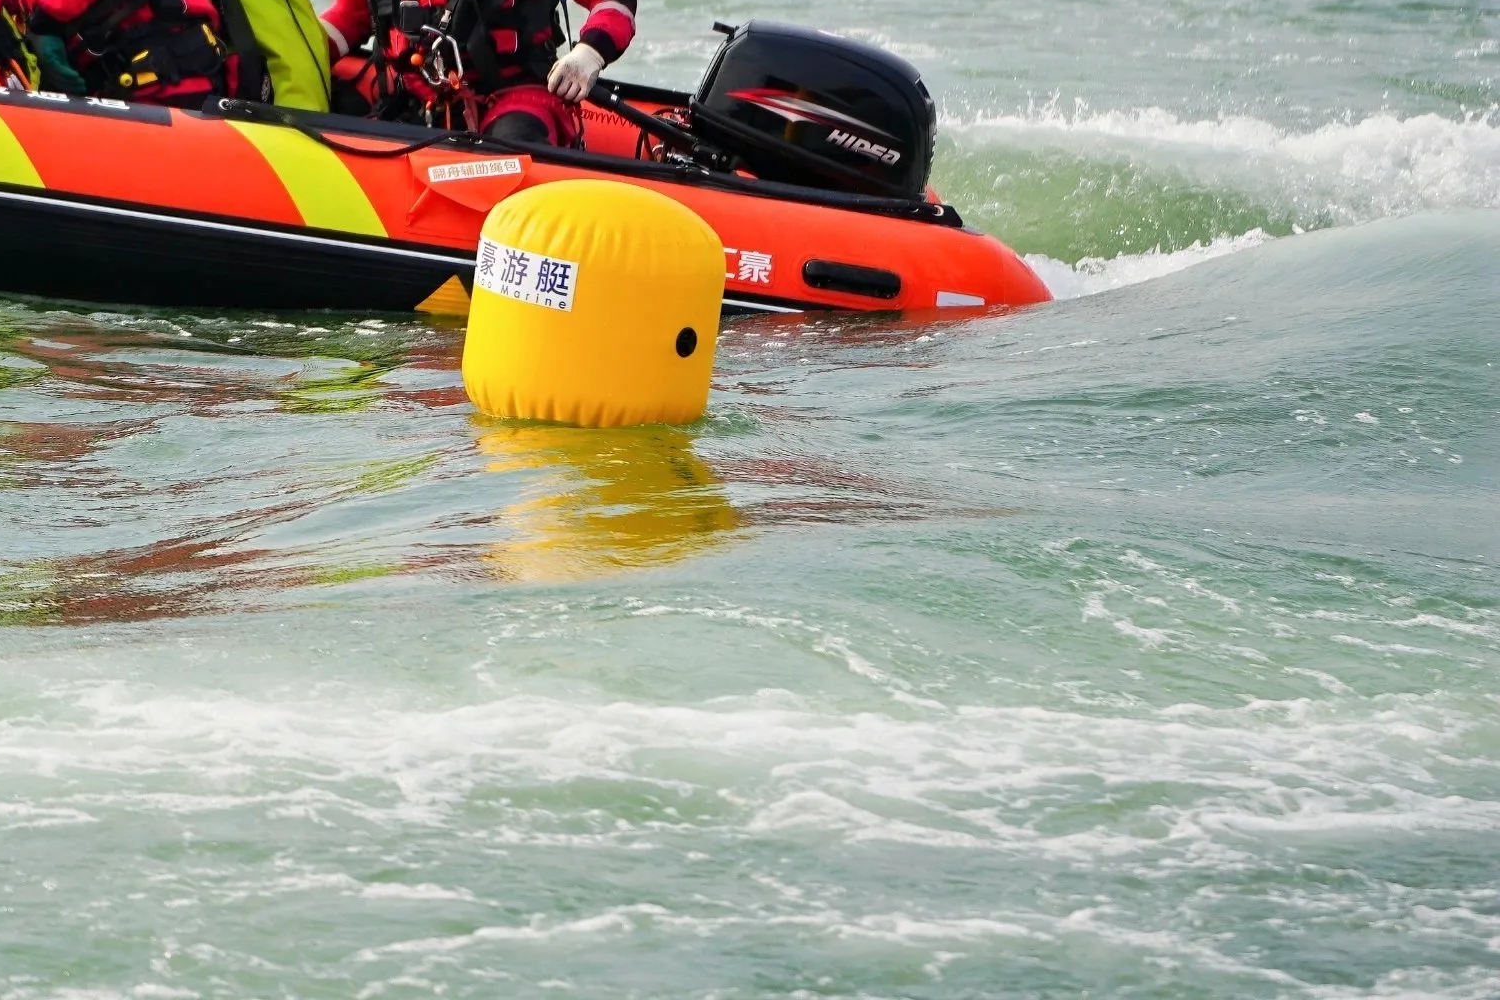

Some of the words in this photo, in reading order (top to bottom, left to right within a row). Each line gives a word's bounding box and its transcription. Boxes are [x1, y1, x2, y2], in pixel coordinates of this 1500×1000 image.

[476, 239, 572, 297] 豪游艇
[500, 285, 568, 310] Marine
